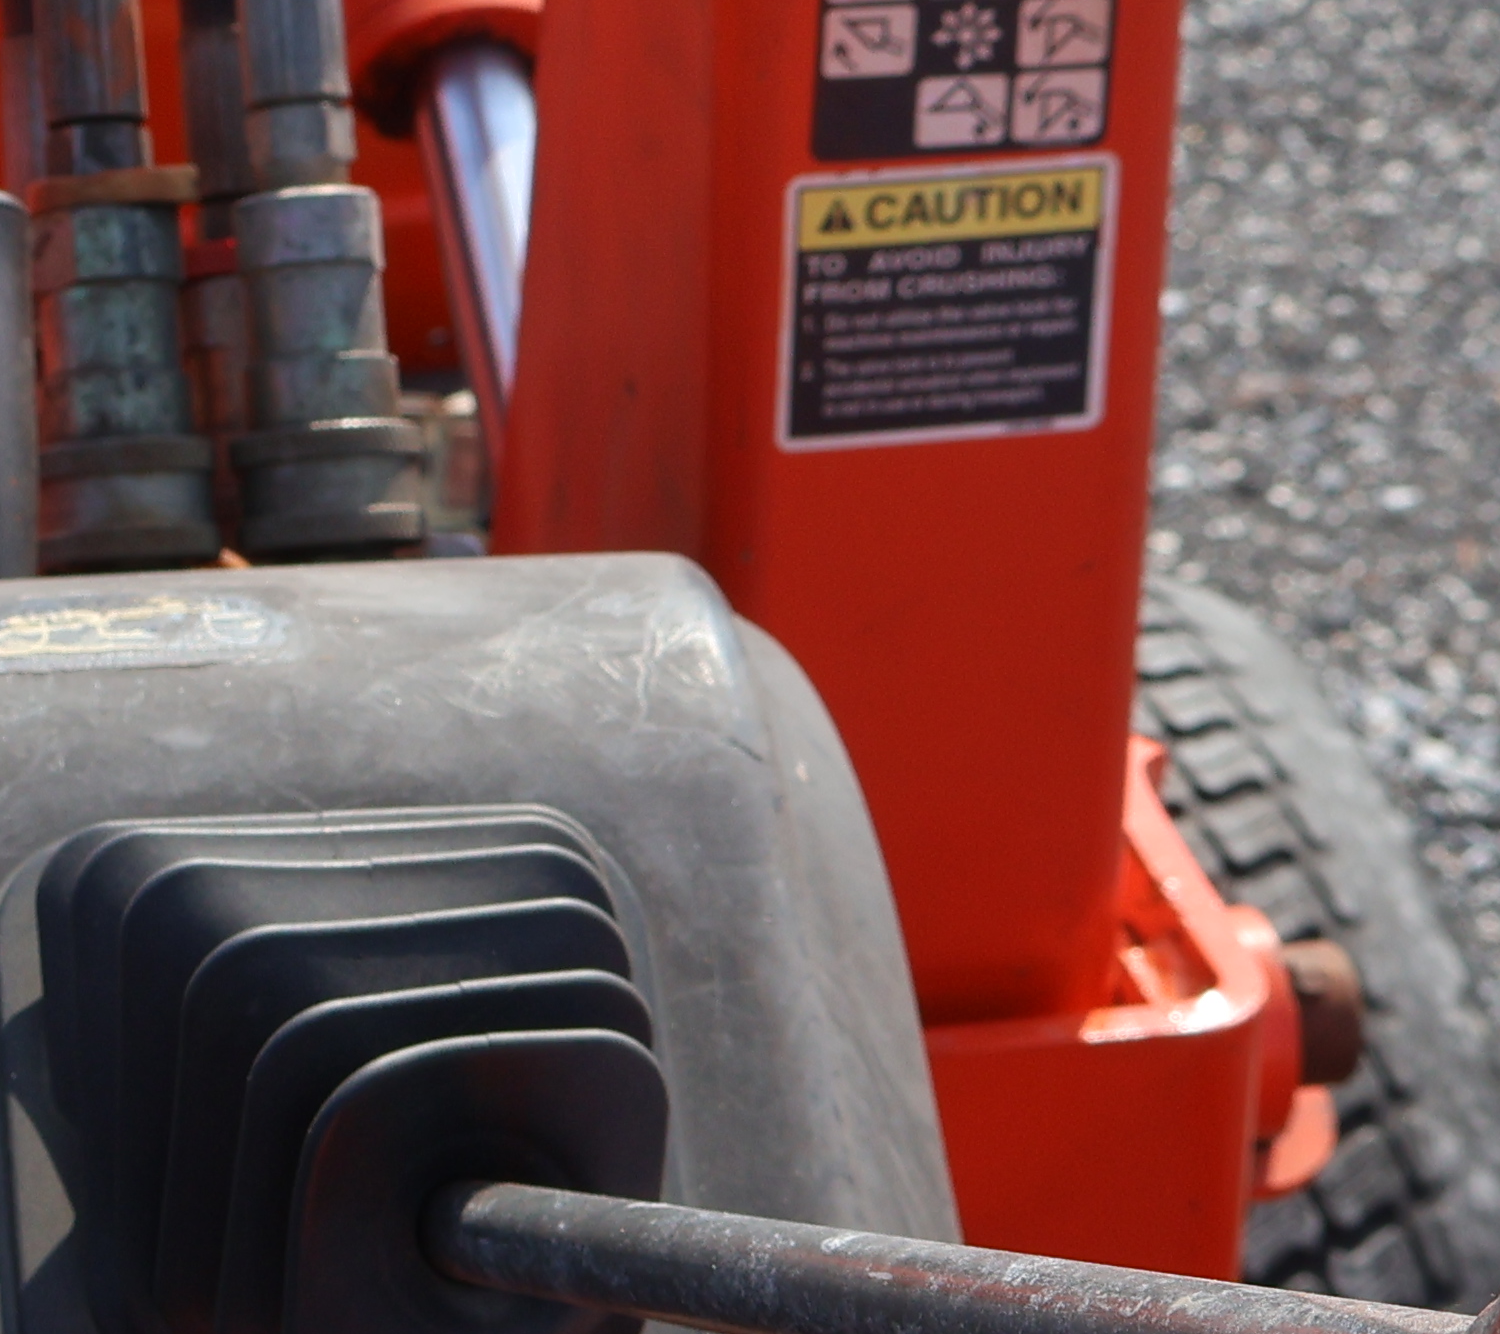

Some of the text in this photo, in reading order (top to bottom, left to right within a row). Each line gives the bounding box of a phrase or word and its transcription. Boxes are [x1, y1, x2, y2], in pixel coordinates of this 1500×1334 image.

[865, 181, 1083, 228] CAUTION
[804, 251, 849, 278] TO
[867, 243, 963, 274] AVOID
[802, 277, 893, 305] FROM
